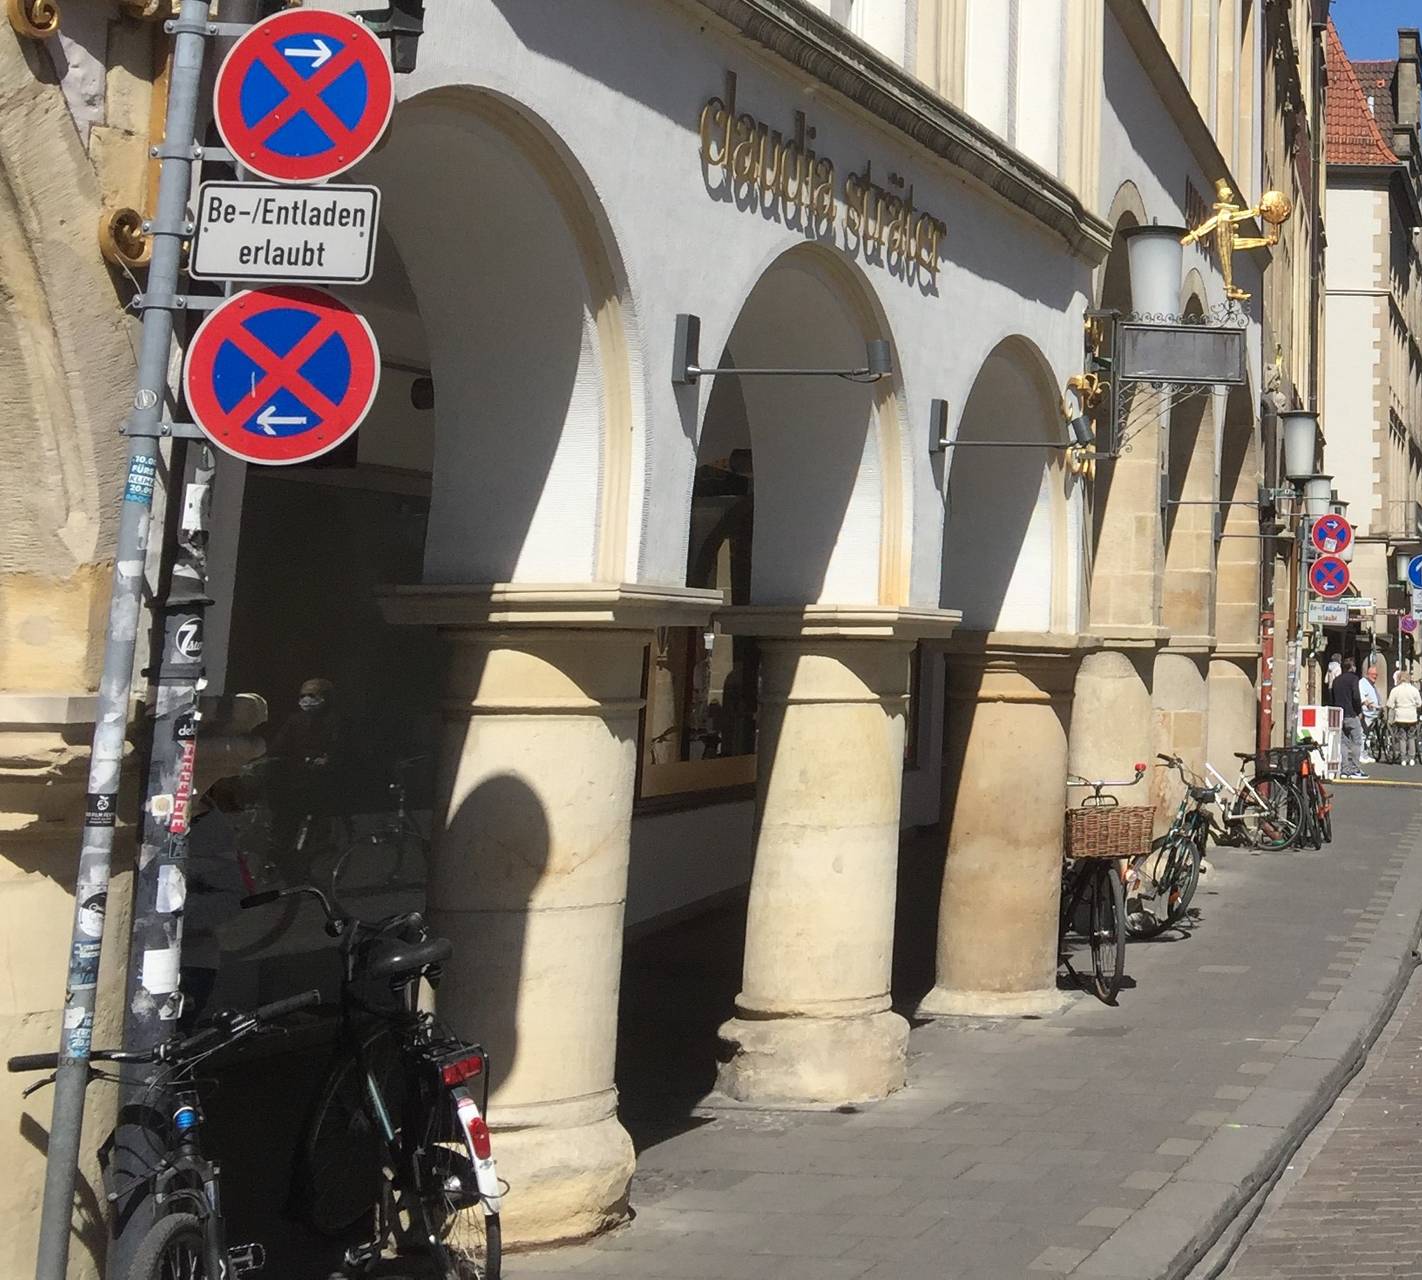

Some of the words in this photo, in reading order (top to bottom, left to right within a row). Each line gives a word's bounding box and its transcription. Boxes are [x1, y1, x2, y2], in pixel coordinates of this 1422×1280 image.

[700, 71, 836, 219] claudia
[846, 160, 946, 273] sträter
[207, 196, 366, 228] Be-/Entladen
[238, 238, 326, 267] erlaubt
[129, 474, 153, 486] KLIM
